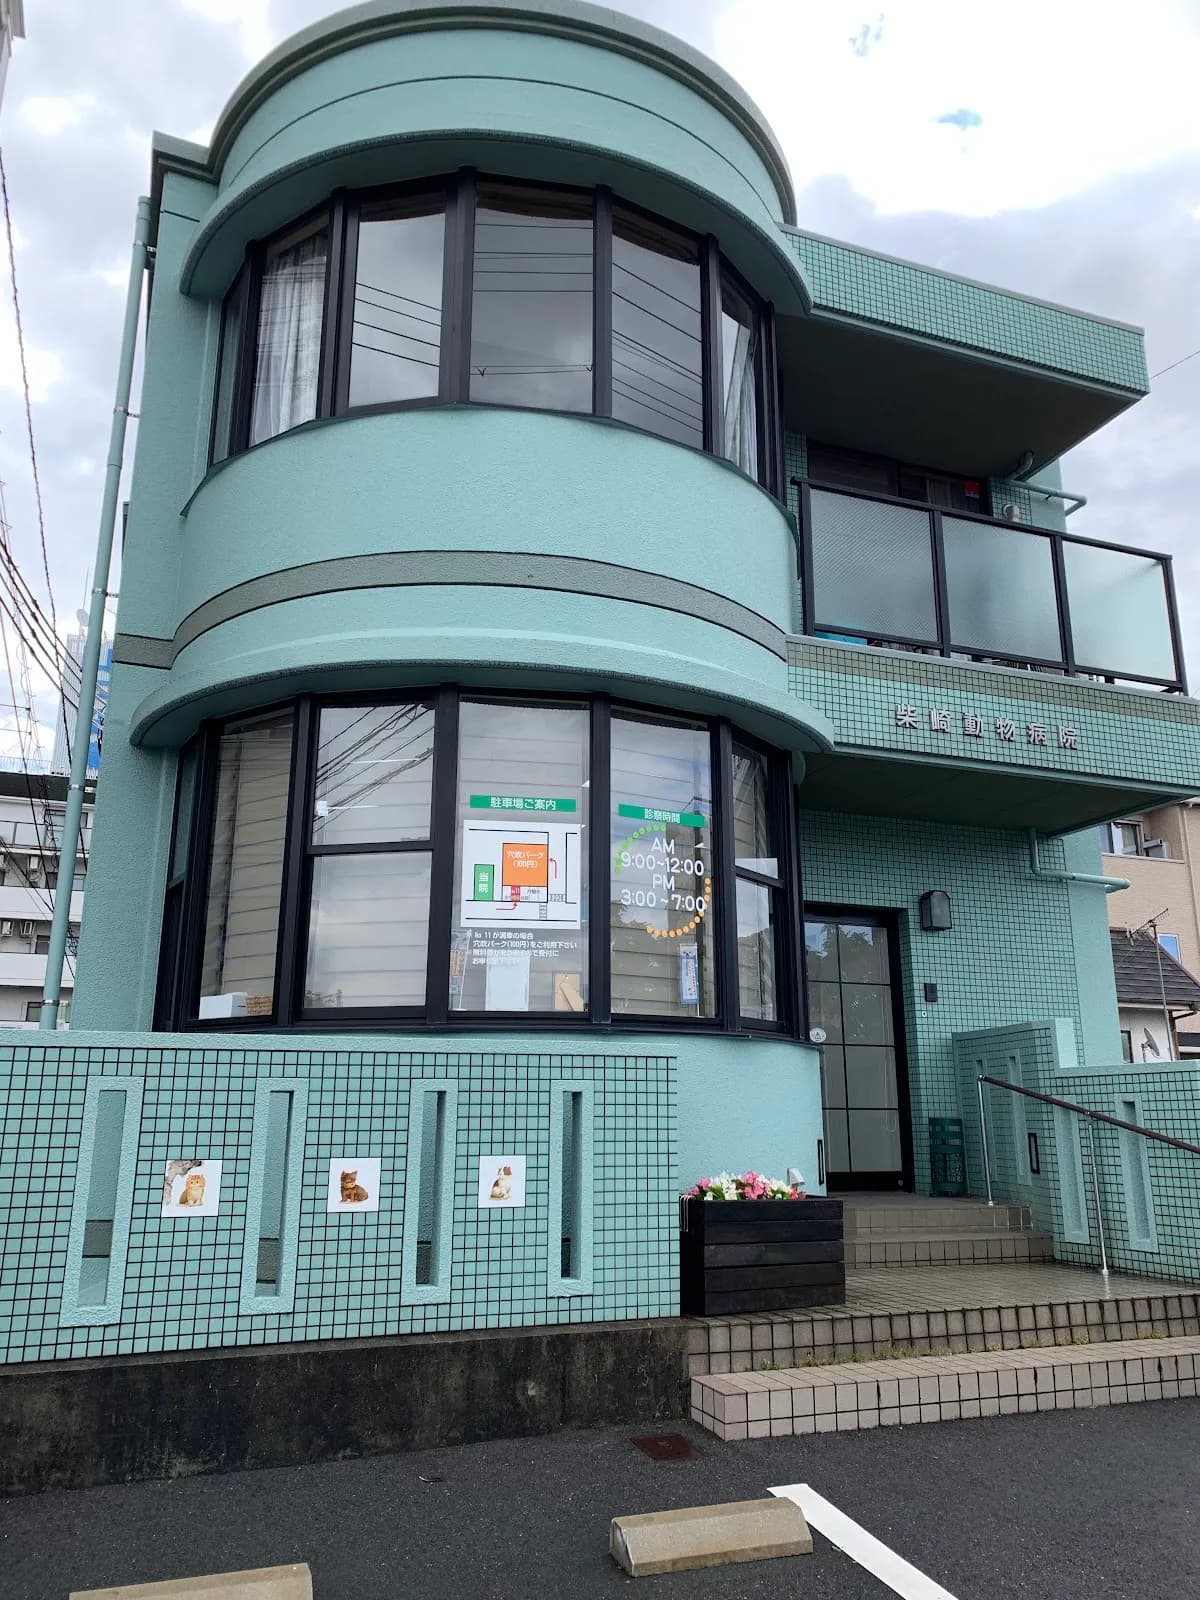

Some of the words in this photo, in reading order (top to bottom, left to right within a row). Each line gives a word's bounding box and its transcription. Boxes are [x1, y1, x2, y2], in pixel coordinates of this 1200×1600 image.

[895, 704, 1078, 750] 柴崎動物病院
[490, 796, 557, 811] 駐車場ご案内
[644, 808, 681, 823] 診察時間
[651, 837, 675, 854] AM
[652, 873, 675, 891] PM
